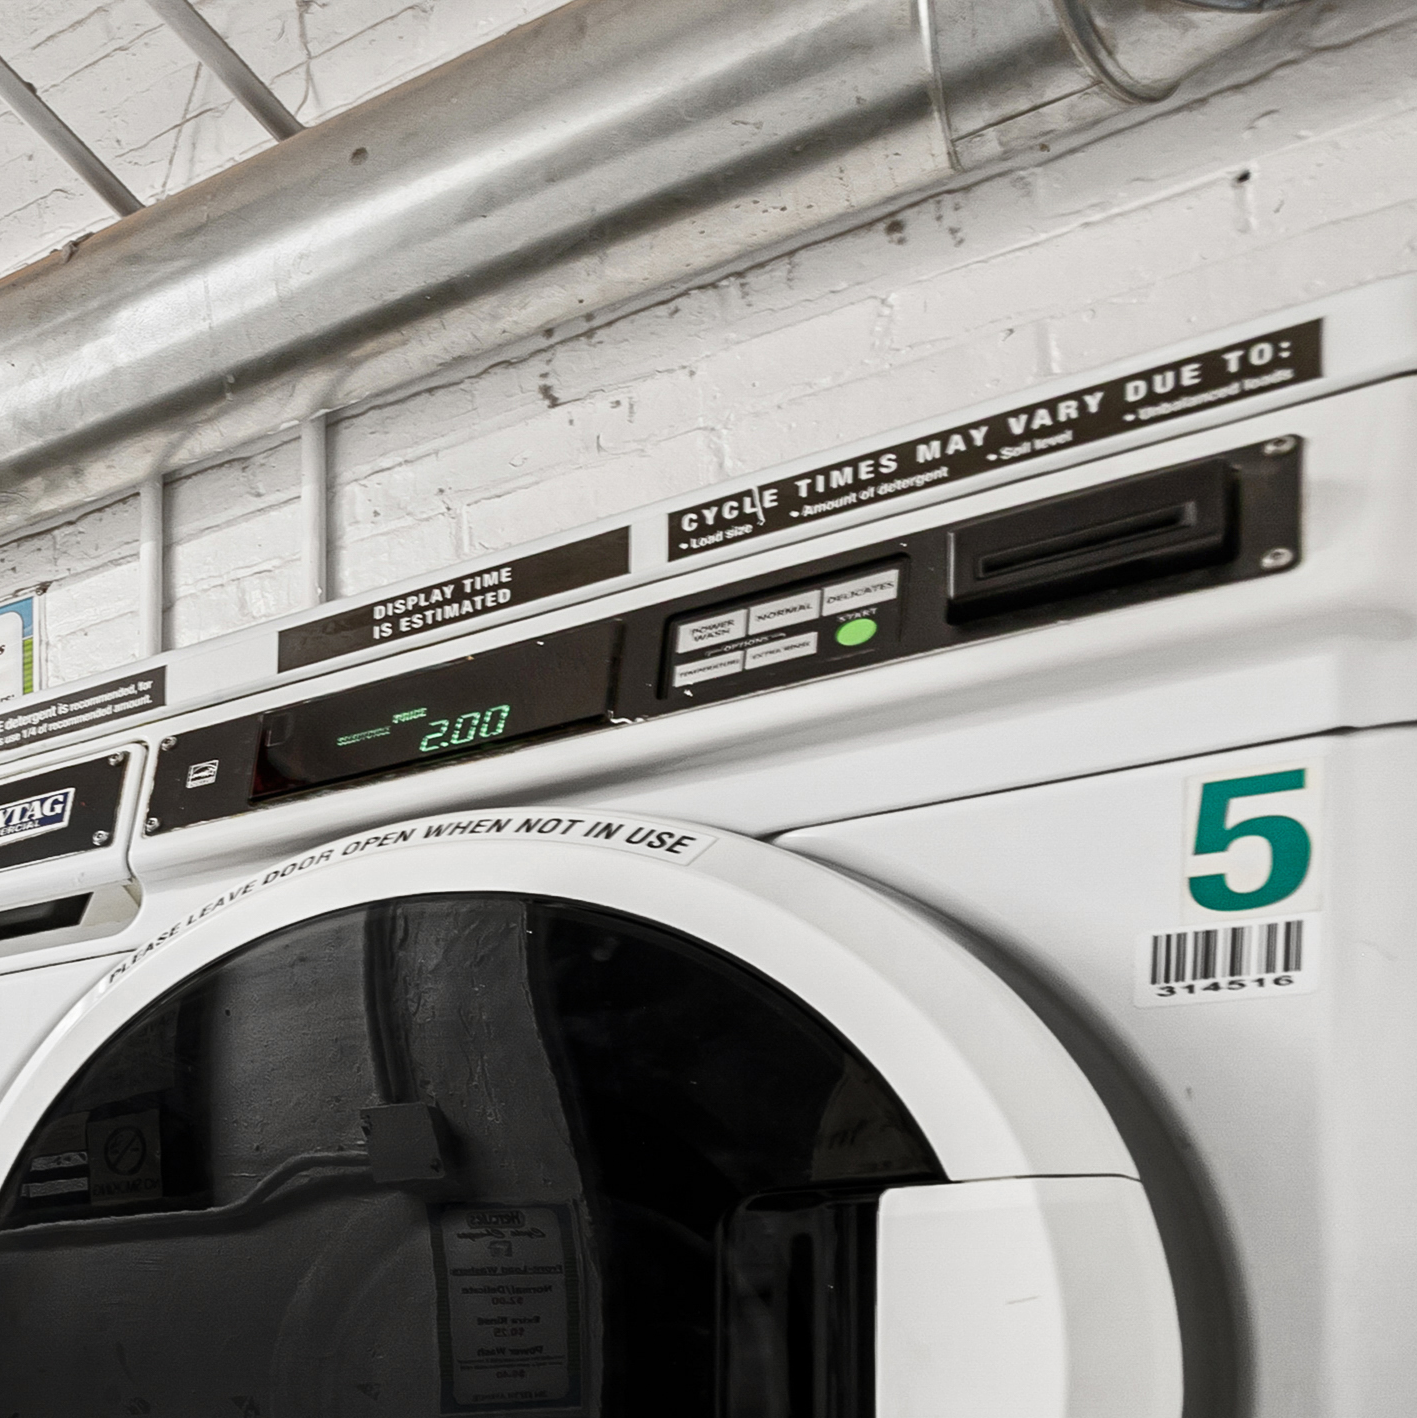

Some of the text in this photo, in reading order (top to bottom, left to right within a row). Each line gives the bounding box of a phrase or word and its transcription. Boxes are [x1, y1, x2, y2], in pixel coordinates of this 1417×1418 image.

[681, 341, 1293, 534] CYCLE TIMES MAY VARY DUE TO:
[690, 532, 723, 548] Load
[725, 522, 753, 538] size
[801, 494, 858, 517] Amount
[860, 487, 874, 500] of
[877, 466, 949, 495] detergent
[373, 567, 512, 620] DISPLAY TIME
[373, 588, 511, 639] IS ESTIMATED
[756, 581, 894, 623] NORMAL DELICATES
[420, 704, 509, 752] 2.00
[1188, 769, 1311, 911] 5
[107, 817, 697, 985] PLEASE LEAVE DOOR OPEN WHEN NOT IN USE
[1157, 975, 1294, 997] 314516
